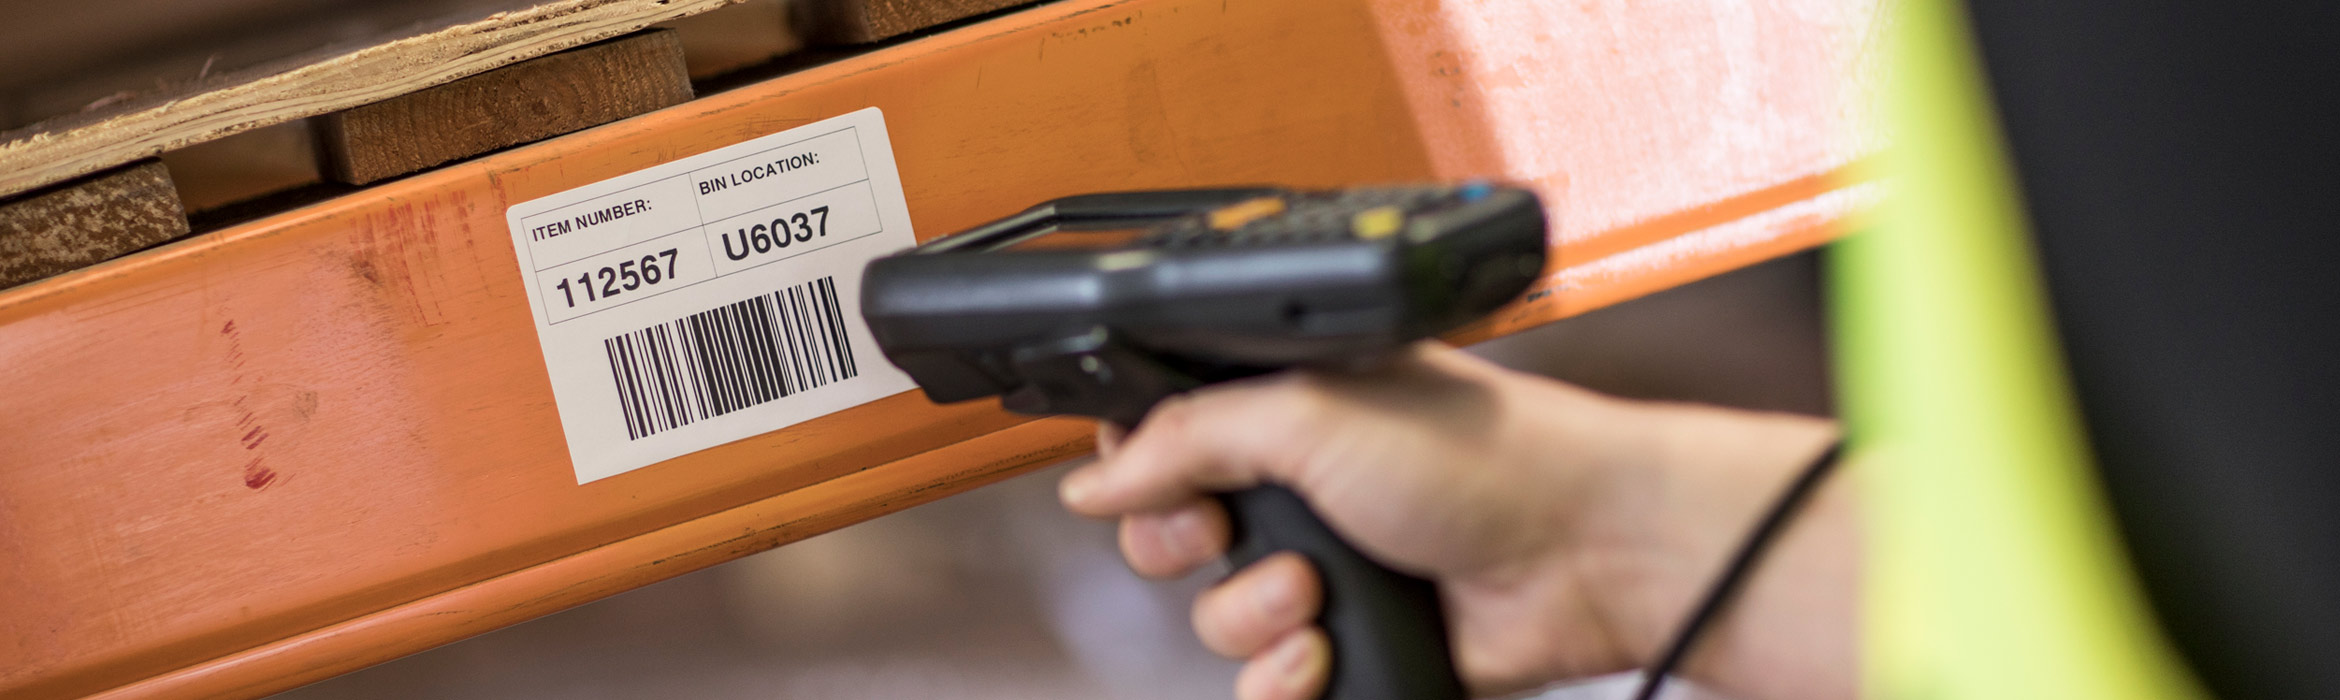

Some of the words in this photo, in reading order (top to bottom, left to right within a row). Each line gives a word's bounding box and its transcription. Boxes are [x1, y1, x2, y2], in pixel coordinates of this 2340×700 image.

[699, 176, 728, 196] BIN
[731, 152, 820, 186] LOCATION:
[532, 218, 572, 242] ITEM
[576, 199, 652, 230] NUMBER:
[722, 205, 830, 262] U6037
[556, 248, 679, 308] 112567
